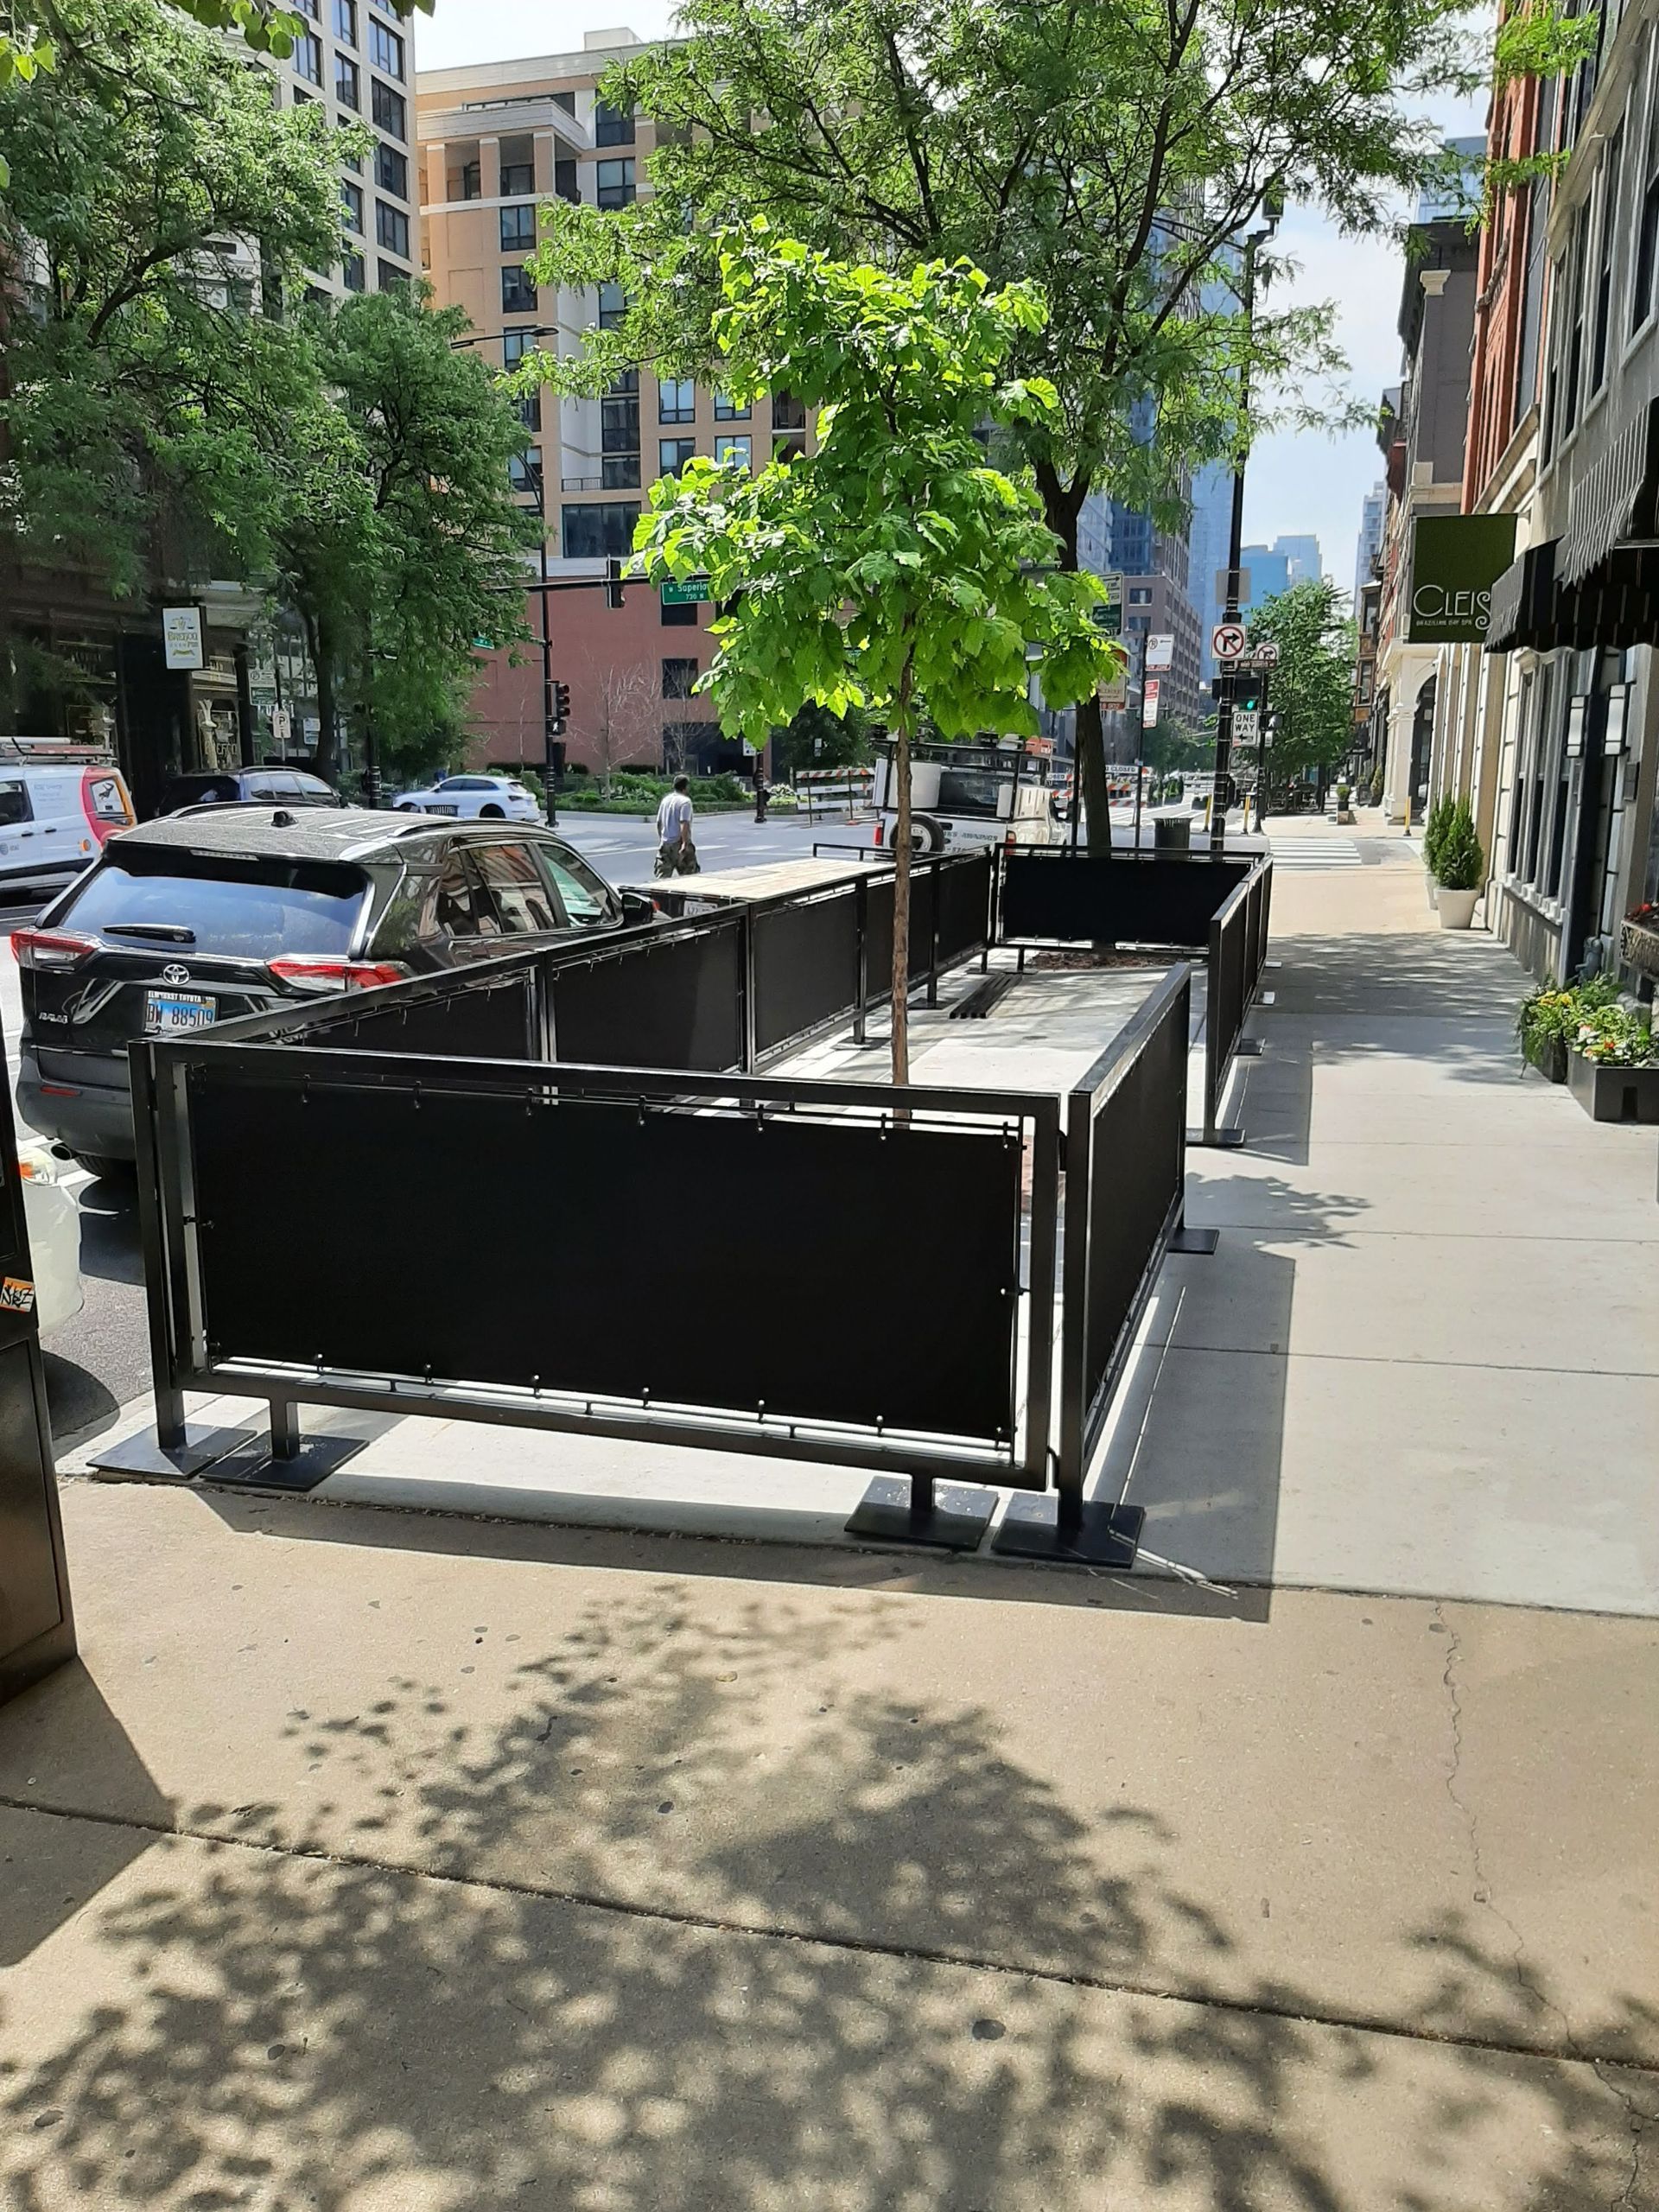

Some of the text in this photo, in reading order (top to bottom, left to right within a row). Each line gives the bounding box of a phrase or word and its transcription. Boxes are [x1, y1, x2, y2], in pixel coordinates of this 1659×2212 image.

[1414, 584, 1491, 630] CLEIS
[1236, 714, 1255, 723] ONE
[1235, 723, 1255, 732] WAY
[179, 993, 202, 1003] TOYOTA
